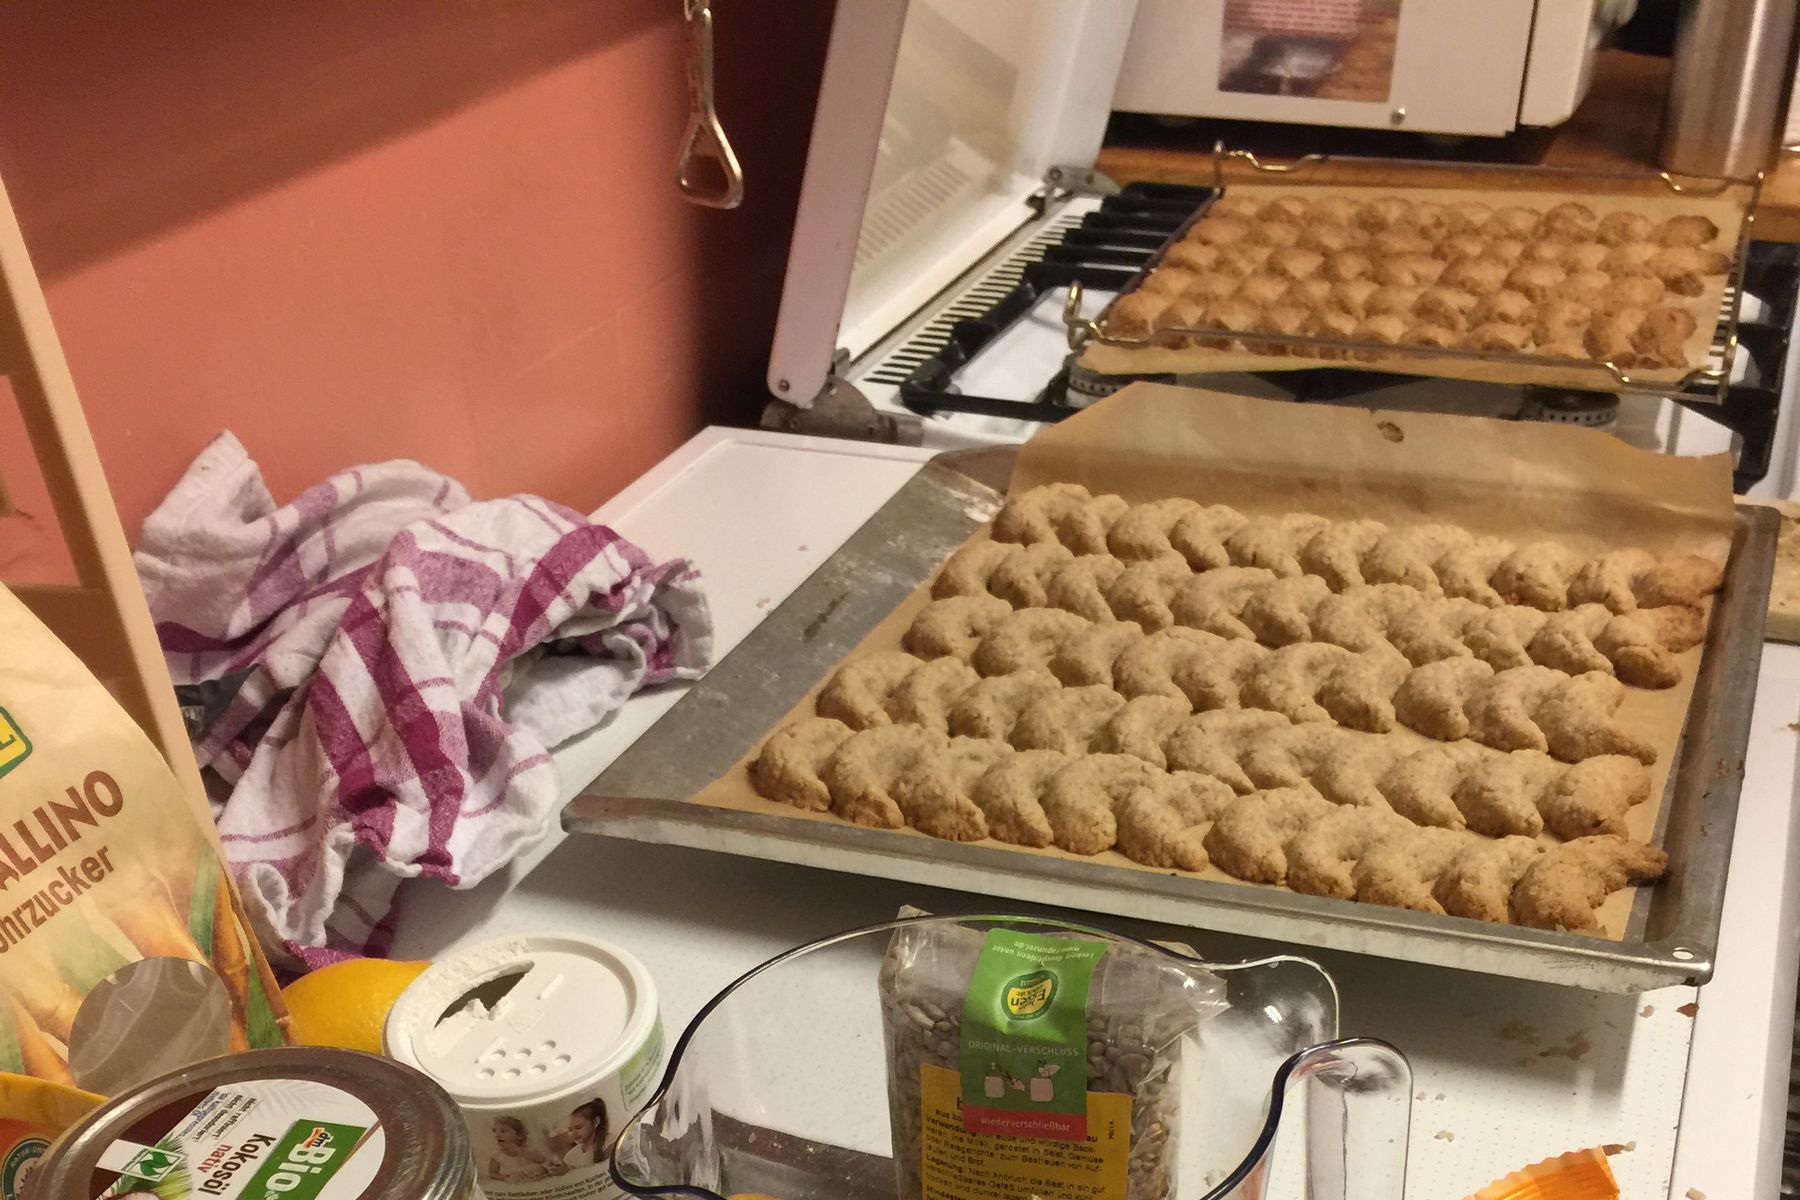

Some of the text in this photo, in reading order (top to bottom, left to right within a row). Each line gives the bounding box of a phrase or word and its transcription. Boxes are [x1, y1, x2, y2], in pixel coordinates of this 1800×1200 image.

[196, 1143, 234, 1174] nativ
[197, 1132, 278, 1197] Kokosöl
[265, 1143, 337, 1193] Bio
